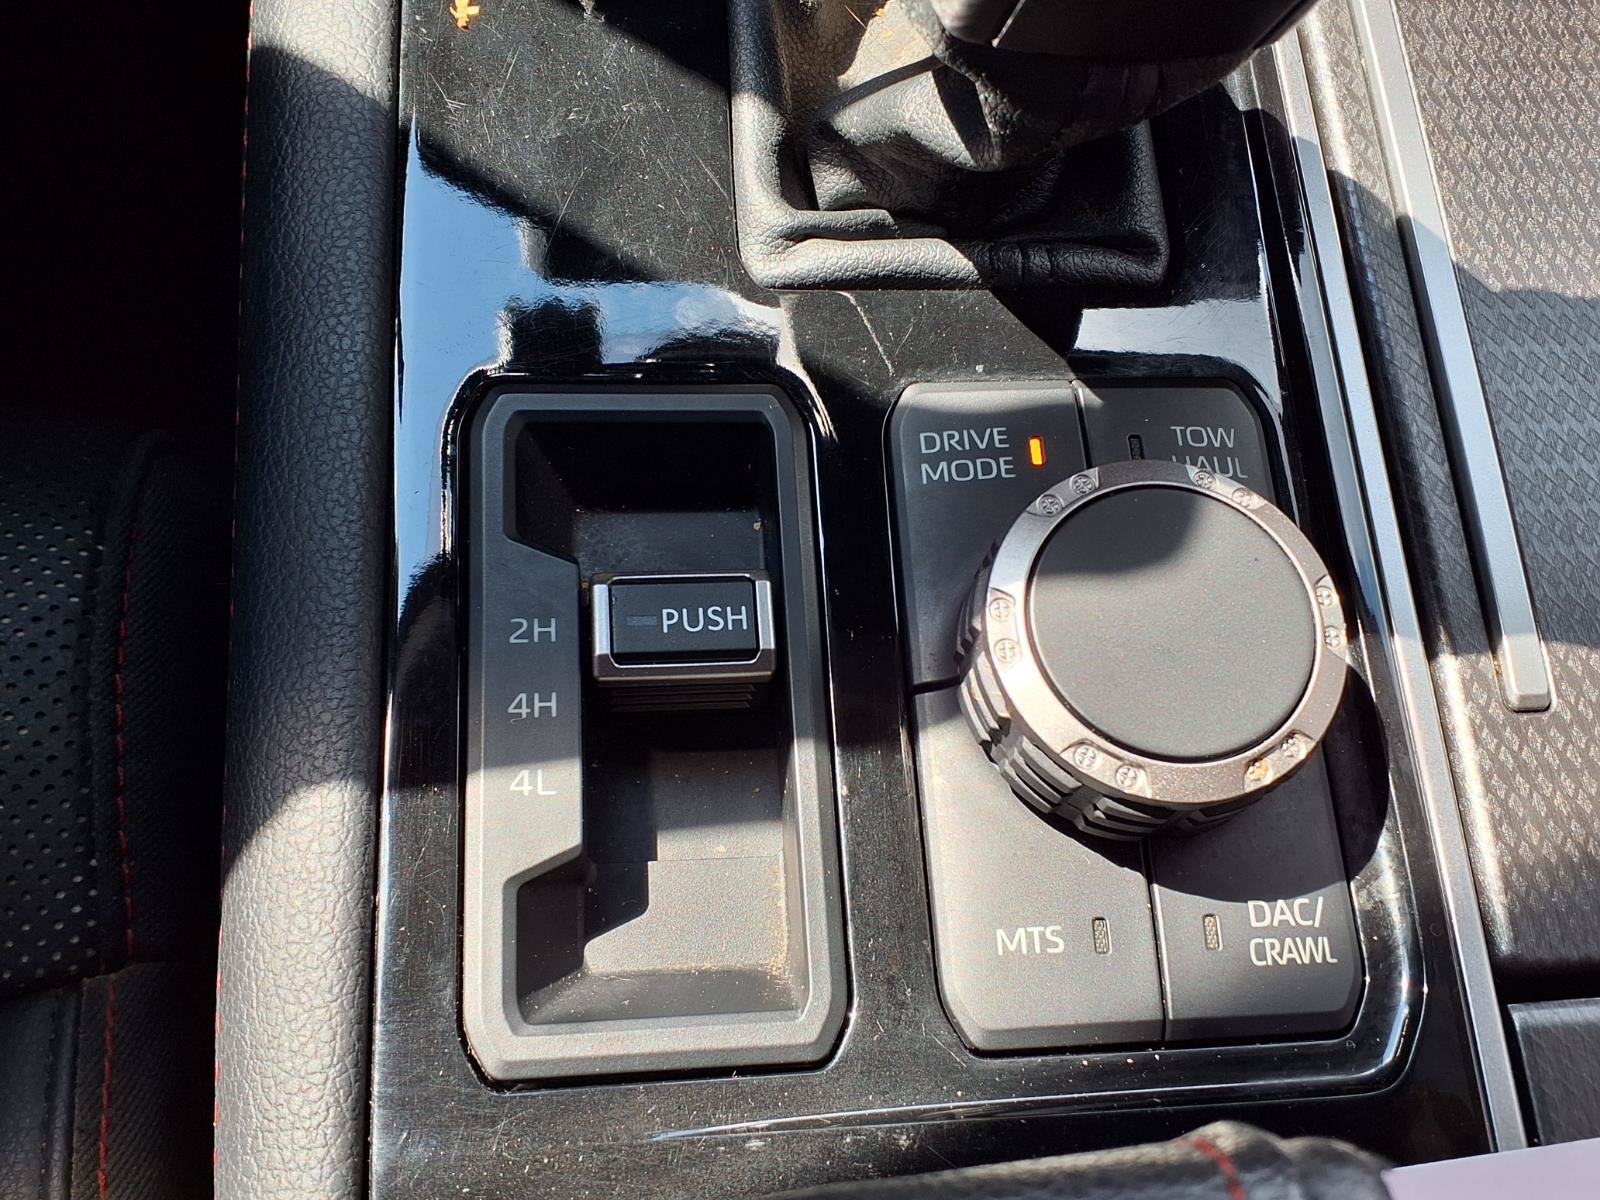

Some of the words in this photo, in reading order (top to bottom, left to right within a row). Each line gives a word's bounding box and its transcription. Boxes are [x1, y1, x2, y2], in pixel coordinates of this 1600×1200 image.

[919, 427, 1010, 454] DRIVE
[1171, 426, 1235, 449] TOW
[921, 457, 1016, 484] MODE
[509, 618, 557, 644] 2H
[662, 606, 747, 633] PUSH
[507, 692, 557, 719] 4H
[509, 769, 557, 796] 4L
[1248, 896, 1323, 928] DAC/
[996, 926, 1065, 955] MTS
[1250, 936, 1338, 966] CRAWL
